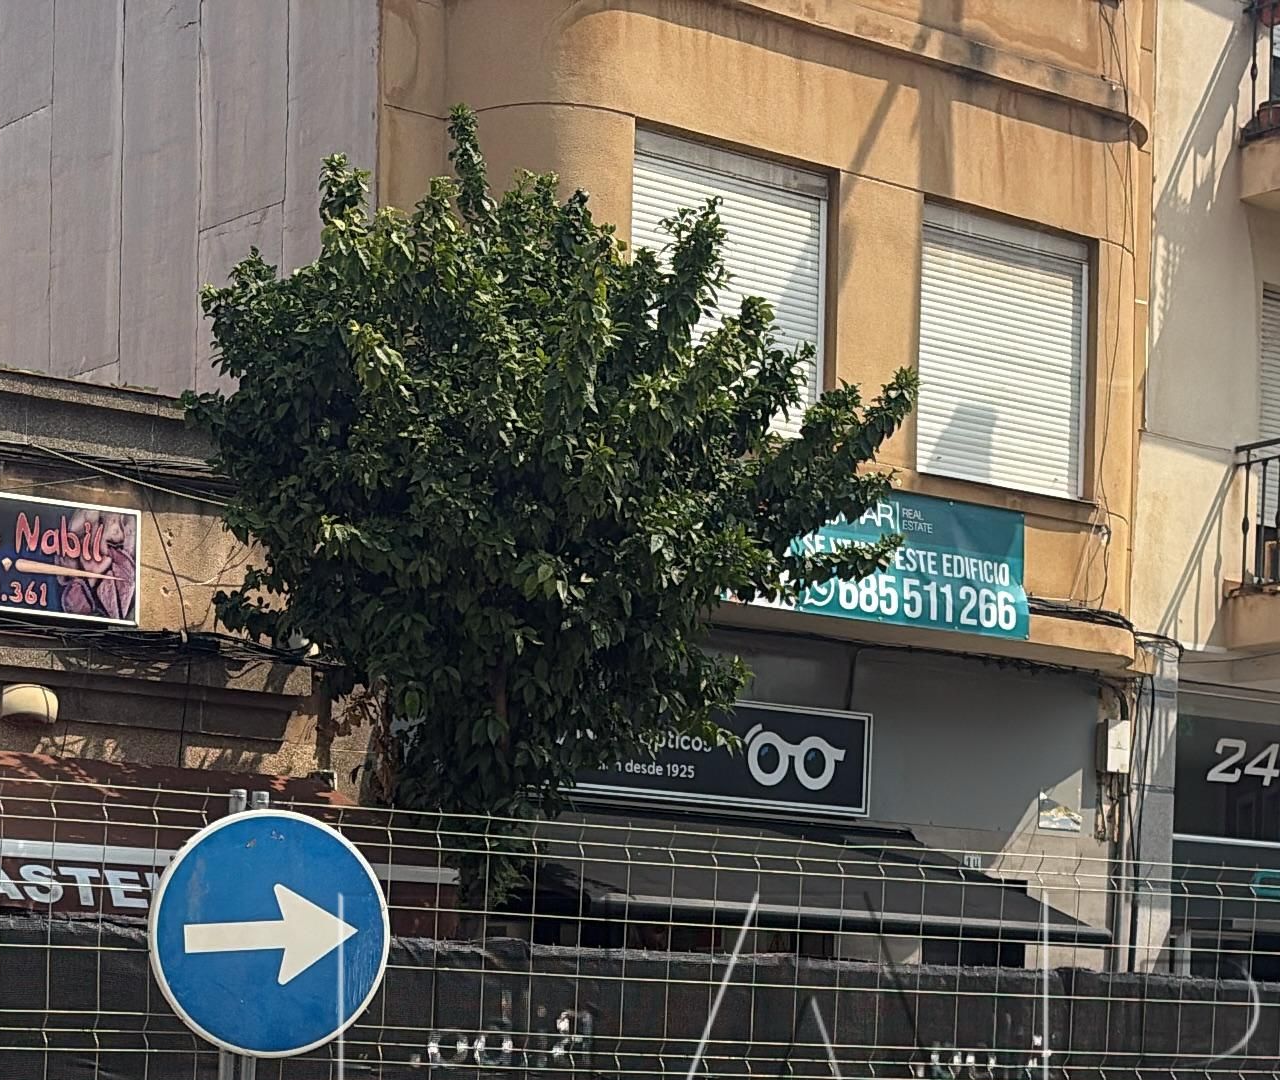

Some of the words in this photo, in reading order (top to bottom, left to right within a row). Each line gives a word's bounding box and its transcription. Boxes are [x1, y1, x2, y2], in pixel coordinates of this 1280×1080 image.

[901, 509, 924, 522] REAL
[901, 519, 933, 534] ESTATE
[14, 511, 105, 563] Nabil
[895, 546, 938, 576] ESTE
[942, 553, 1010, 587] EDIFICIO
[838, 574, 900, 616] 685
[902, 578, 953, 623] 511
[959, 583, 1017, 631] 266
[624, 759, 664, 776] desde
[666, 763, 696, 780] 1925
[1206, 737, 1280, 787] 24
